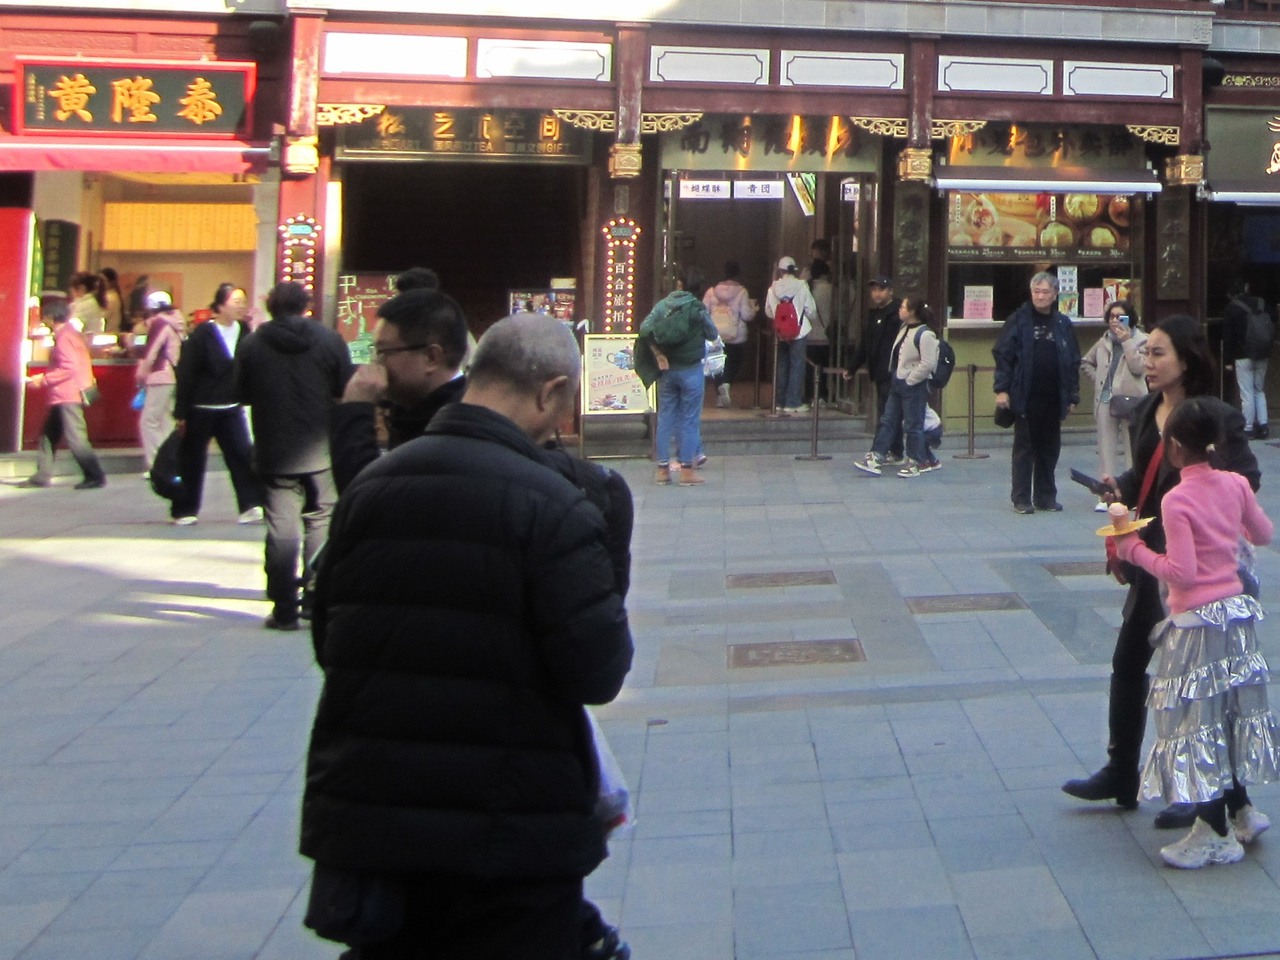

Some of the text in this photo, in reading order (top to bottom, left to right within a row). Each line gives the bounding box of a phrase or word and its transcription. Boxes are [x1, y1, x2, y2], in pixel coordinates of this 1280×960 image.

[747, 183, 771, 195] 青团
[612, 262, 626, 323] 百合旅拍
